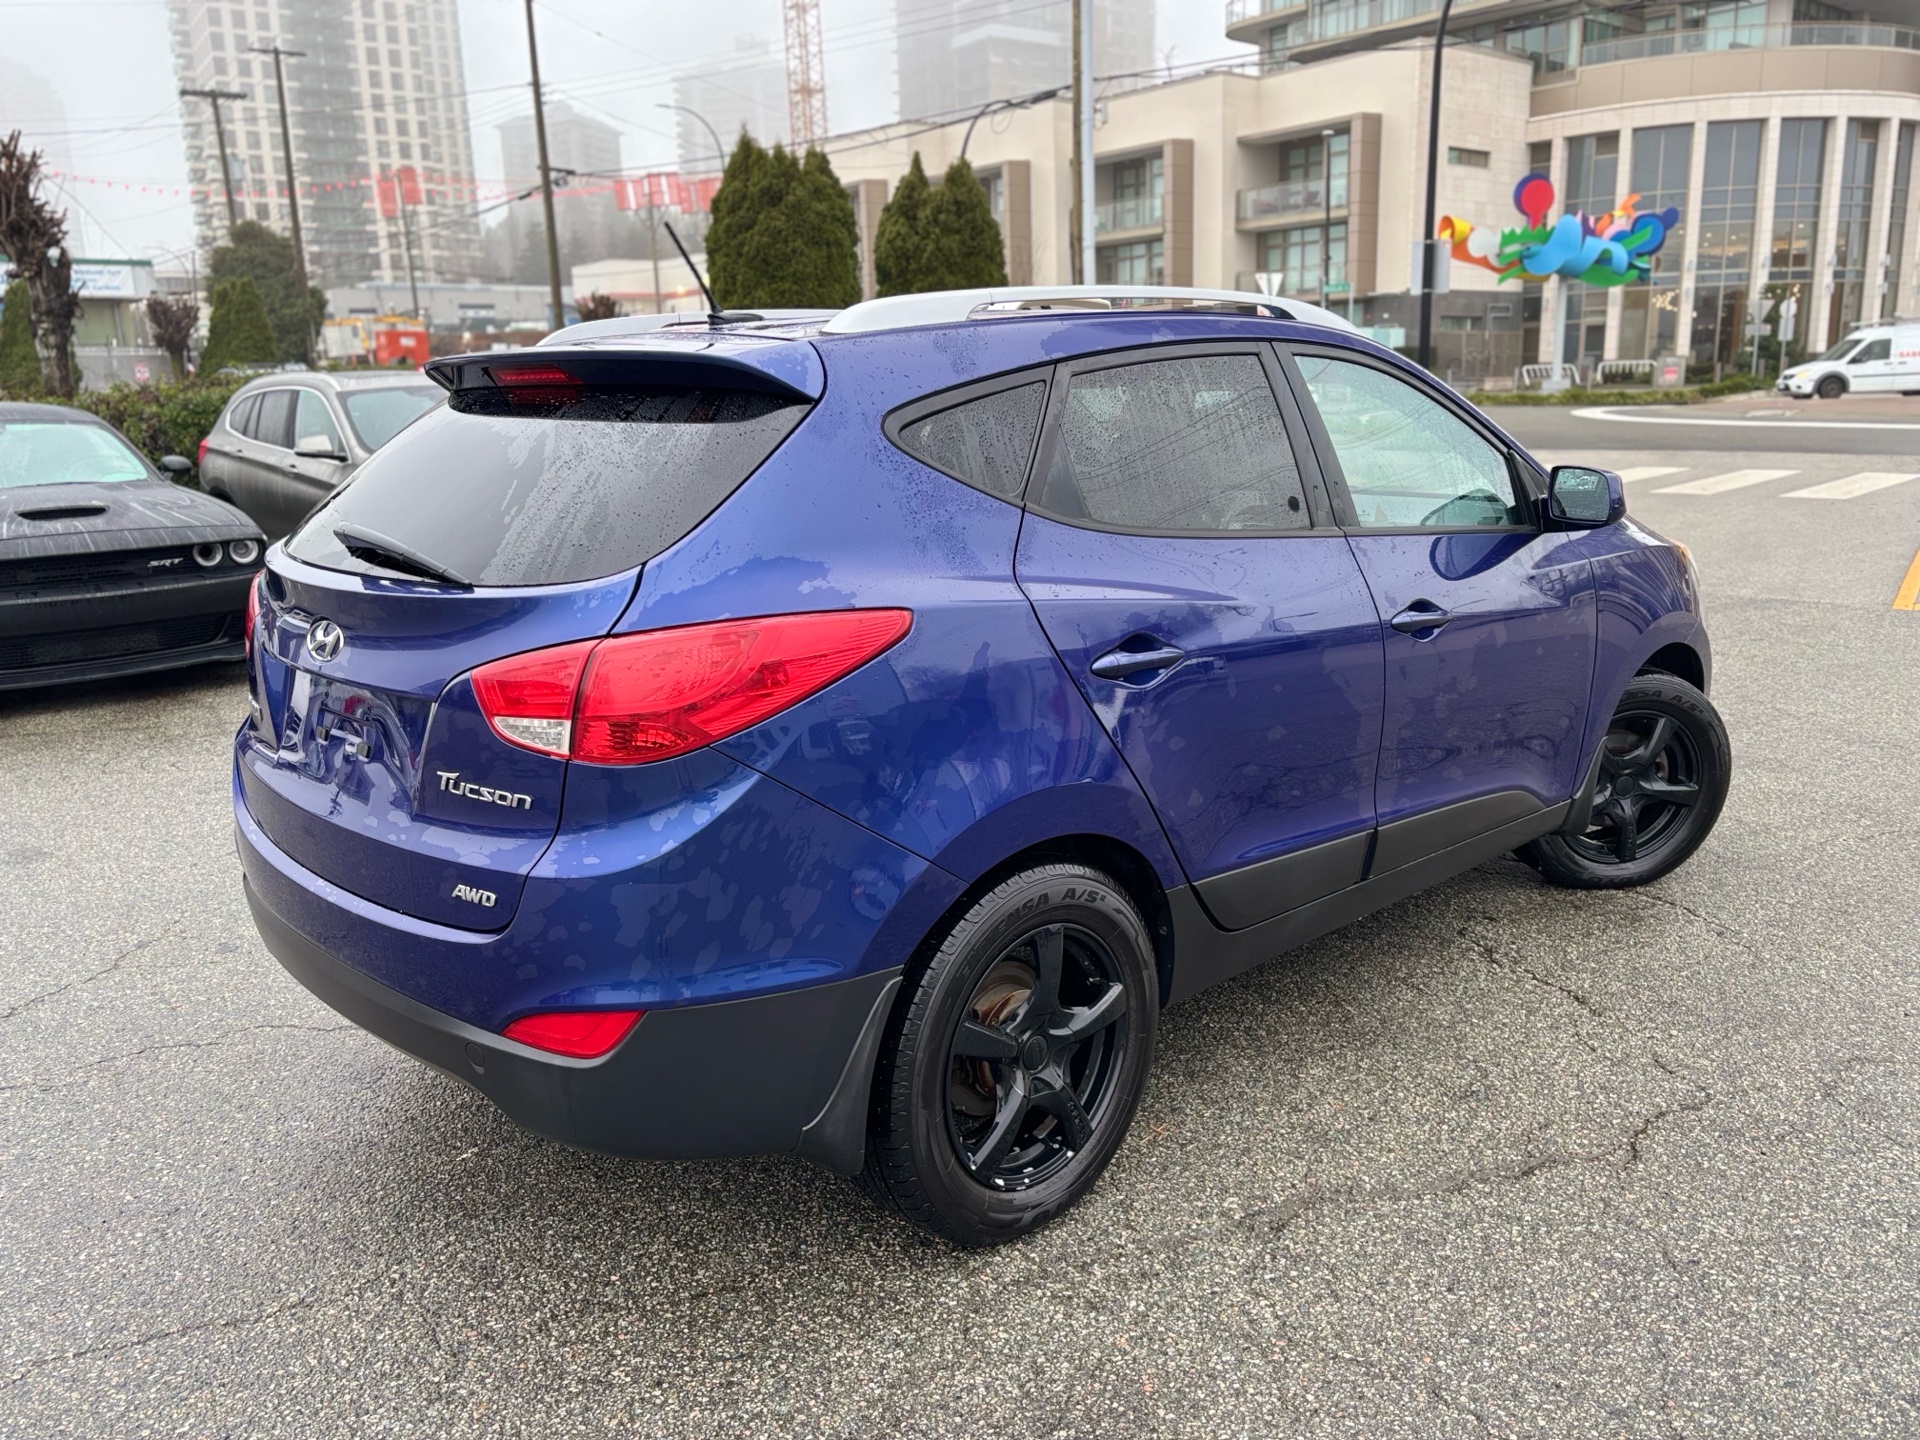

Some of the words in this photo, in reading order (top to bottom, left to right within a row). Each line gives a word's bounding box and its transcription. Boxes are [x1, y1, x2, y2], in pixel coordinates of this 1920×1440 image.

[147, 558, 183, 567] SRT
[437, 771, 532, 810] Tucson
[451, 884, 498, 907] AWD
